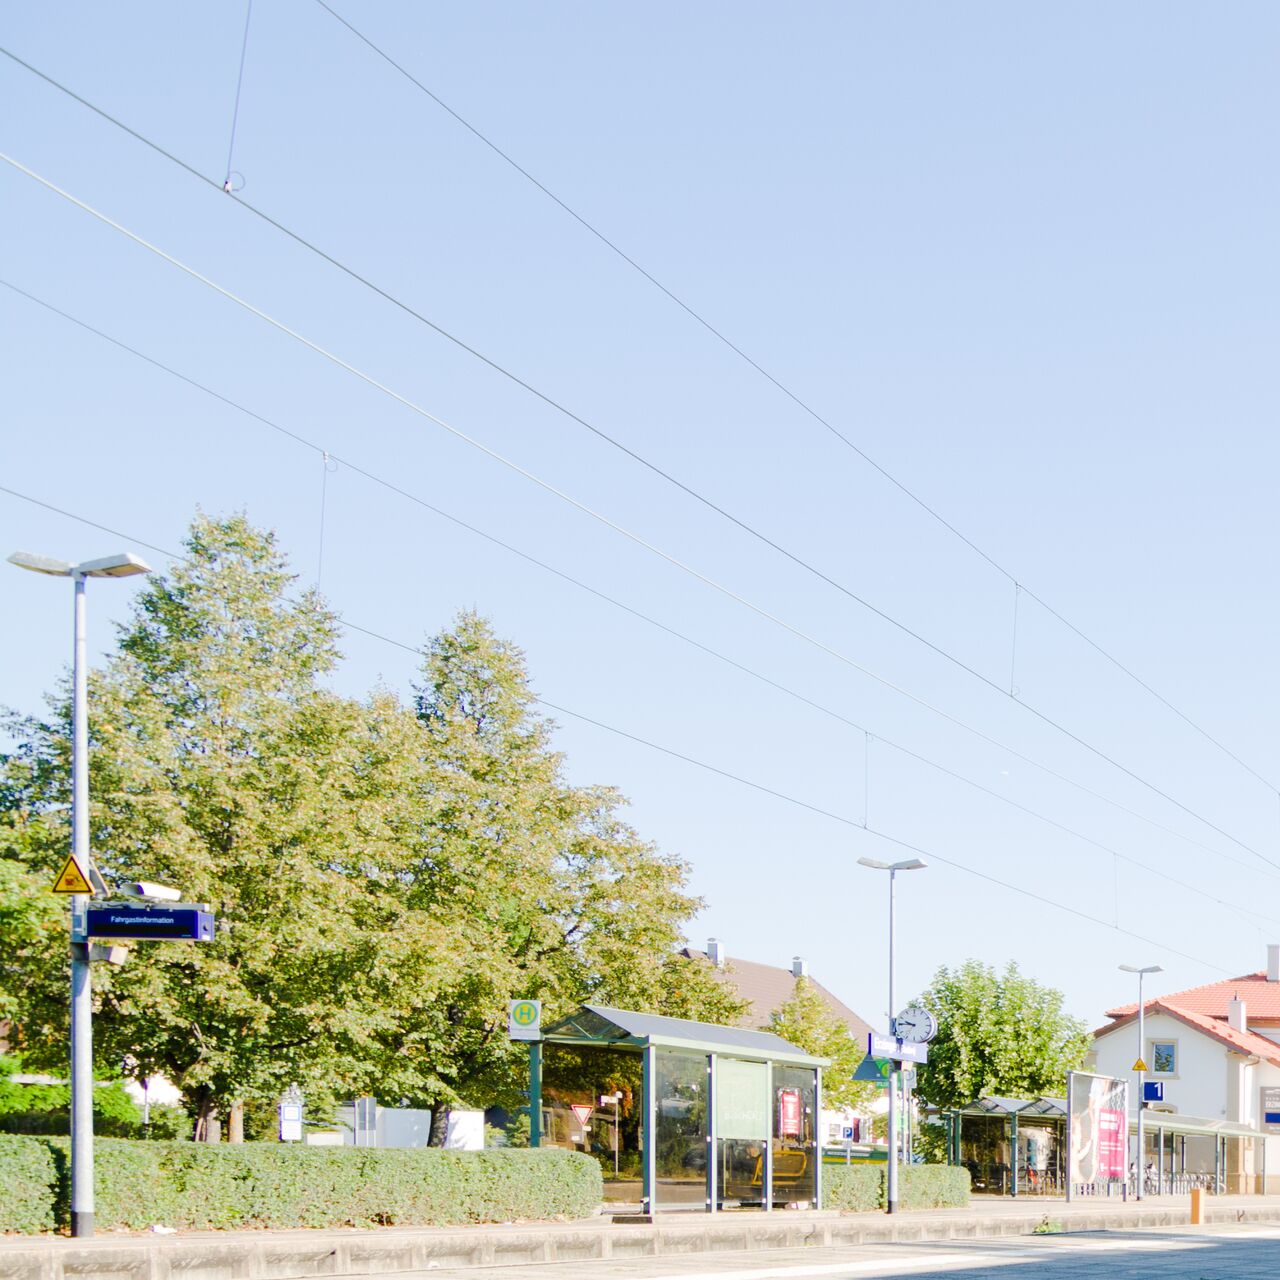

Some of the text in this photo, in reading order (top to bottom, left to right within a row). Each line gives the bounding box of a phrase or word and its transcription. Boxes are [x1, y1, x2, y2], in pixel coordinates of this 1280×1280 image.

[110, 915, 175, 925] Fahrgastinformation
[519, 1007, 531, 1020] H
[1154, 1082, 1162, 1097] 1
[844, 1127, 852, 1138] P
